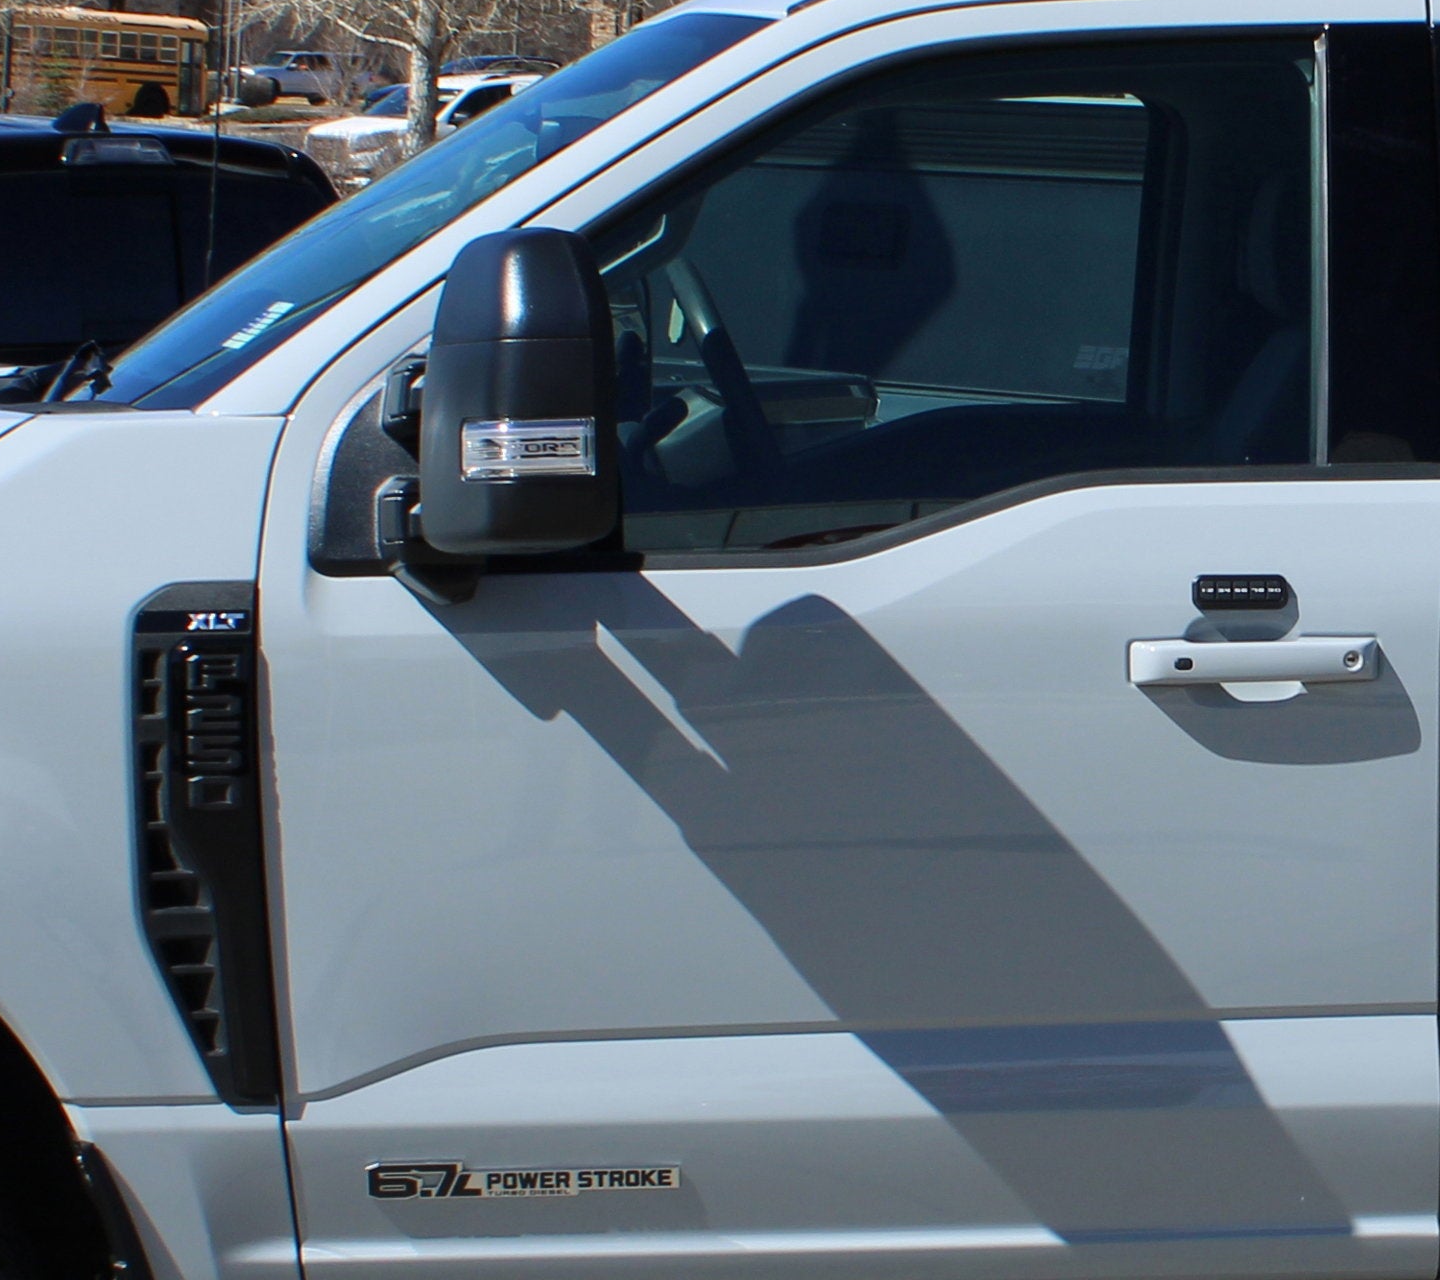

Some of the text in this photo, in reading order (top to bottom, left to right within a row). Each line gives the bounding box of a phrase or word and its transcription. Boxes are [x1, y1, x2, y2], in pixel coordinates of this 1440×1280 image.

[185, 612, 245, 631] XLT
[486, 1171, 571, 1190] POWER
[577, 1168, 673, 1188] STROKE
